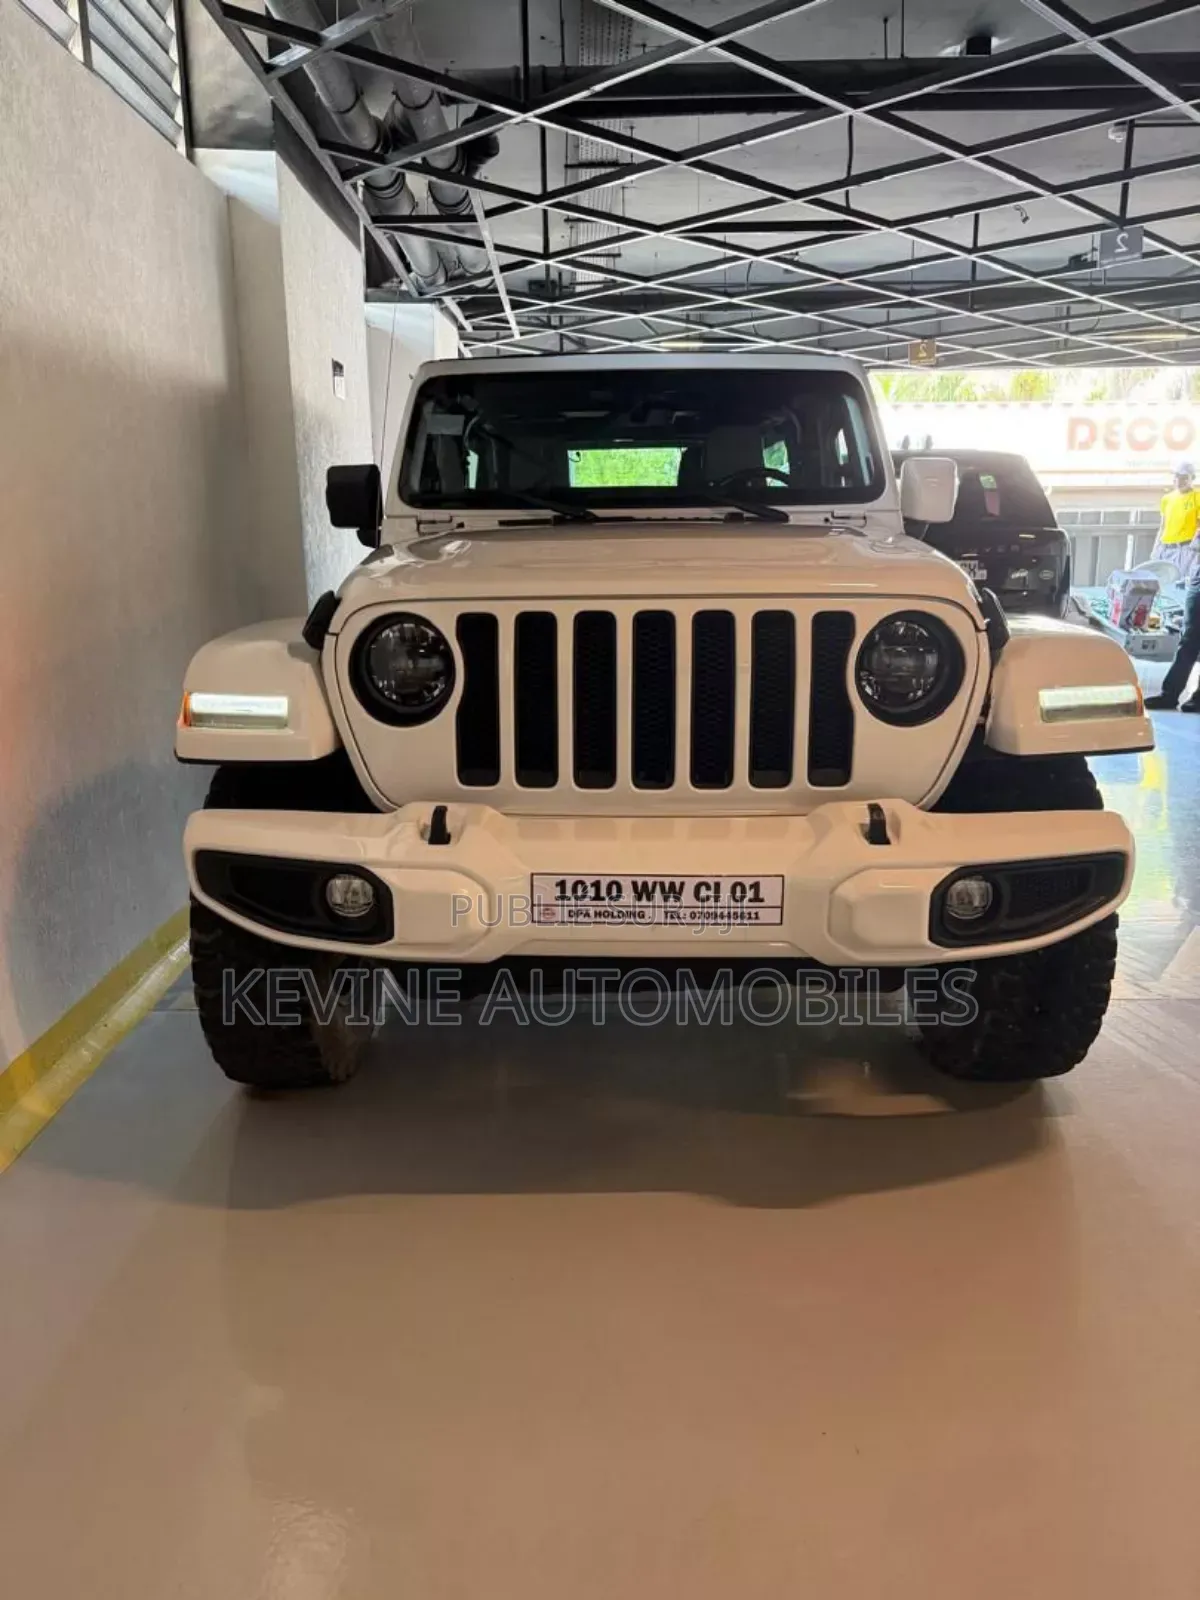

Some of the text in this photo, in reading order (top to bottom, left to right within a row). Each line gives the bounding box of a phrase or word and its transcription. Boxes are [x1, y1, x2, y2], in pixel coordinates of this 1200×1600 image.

[1067, 416, 1196, 451] DECO
[555, 879, 624, 902] 1010
[631, 880, 685, 903] WW
[730, 881, 765, 903] 01
